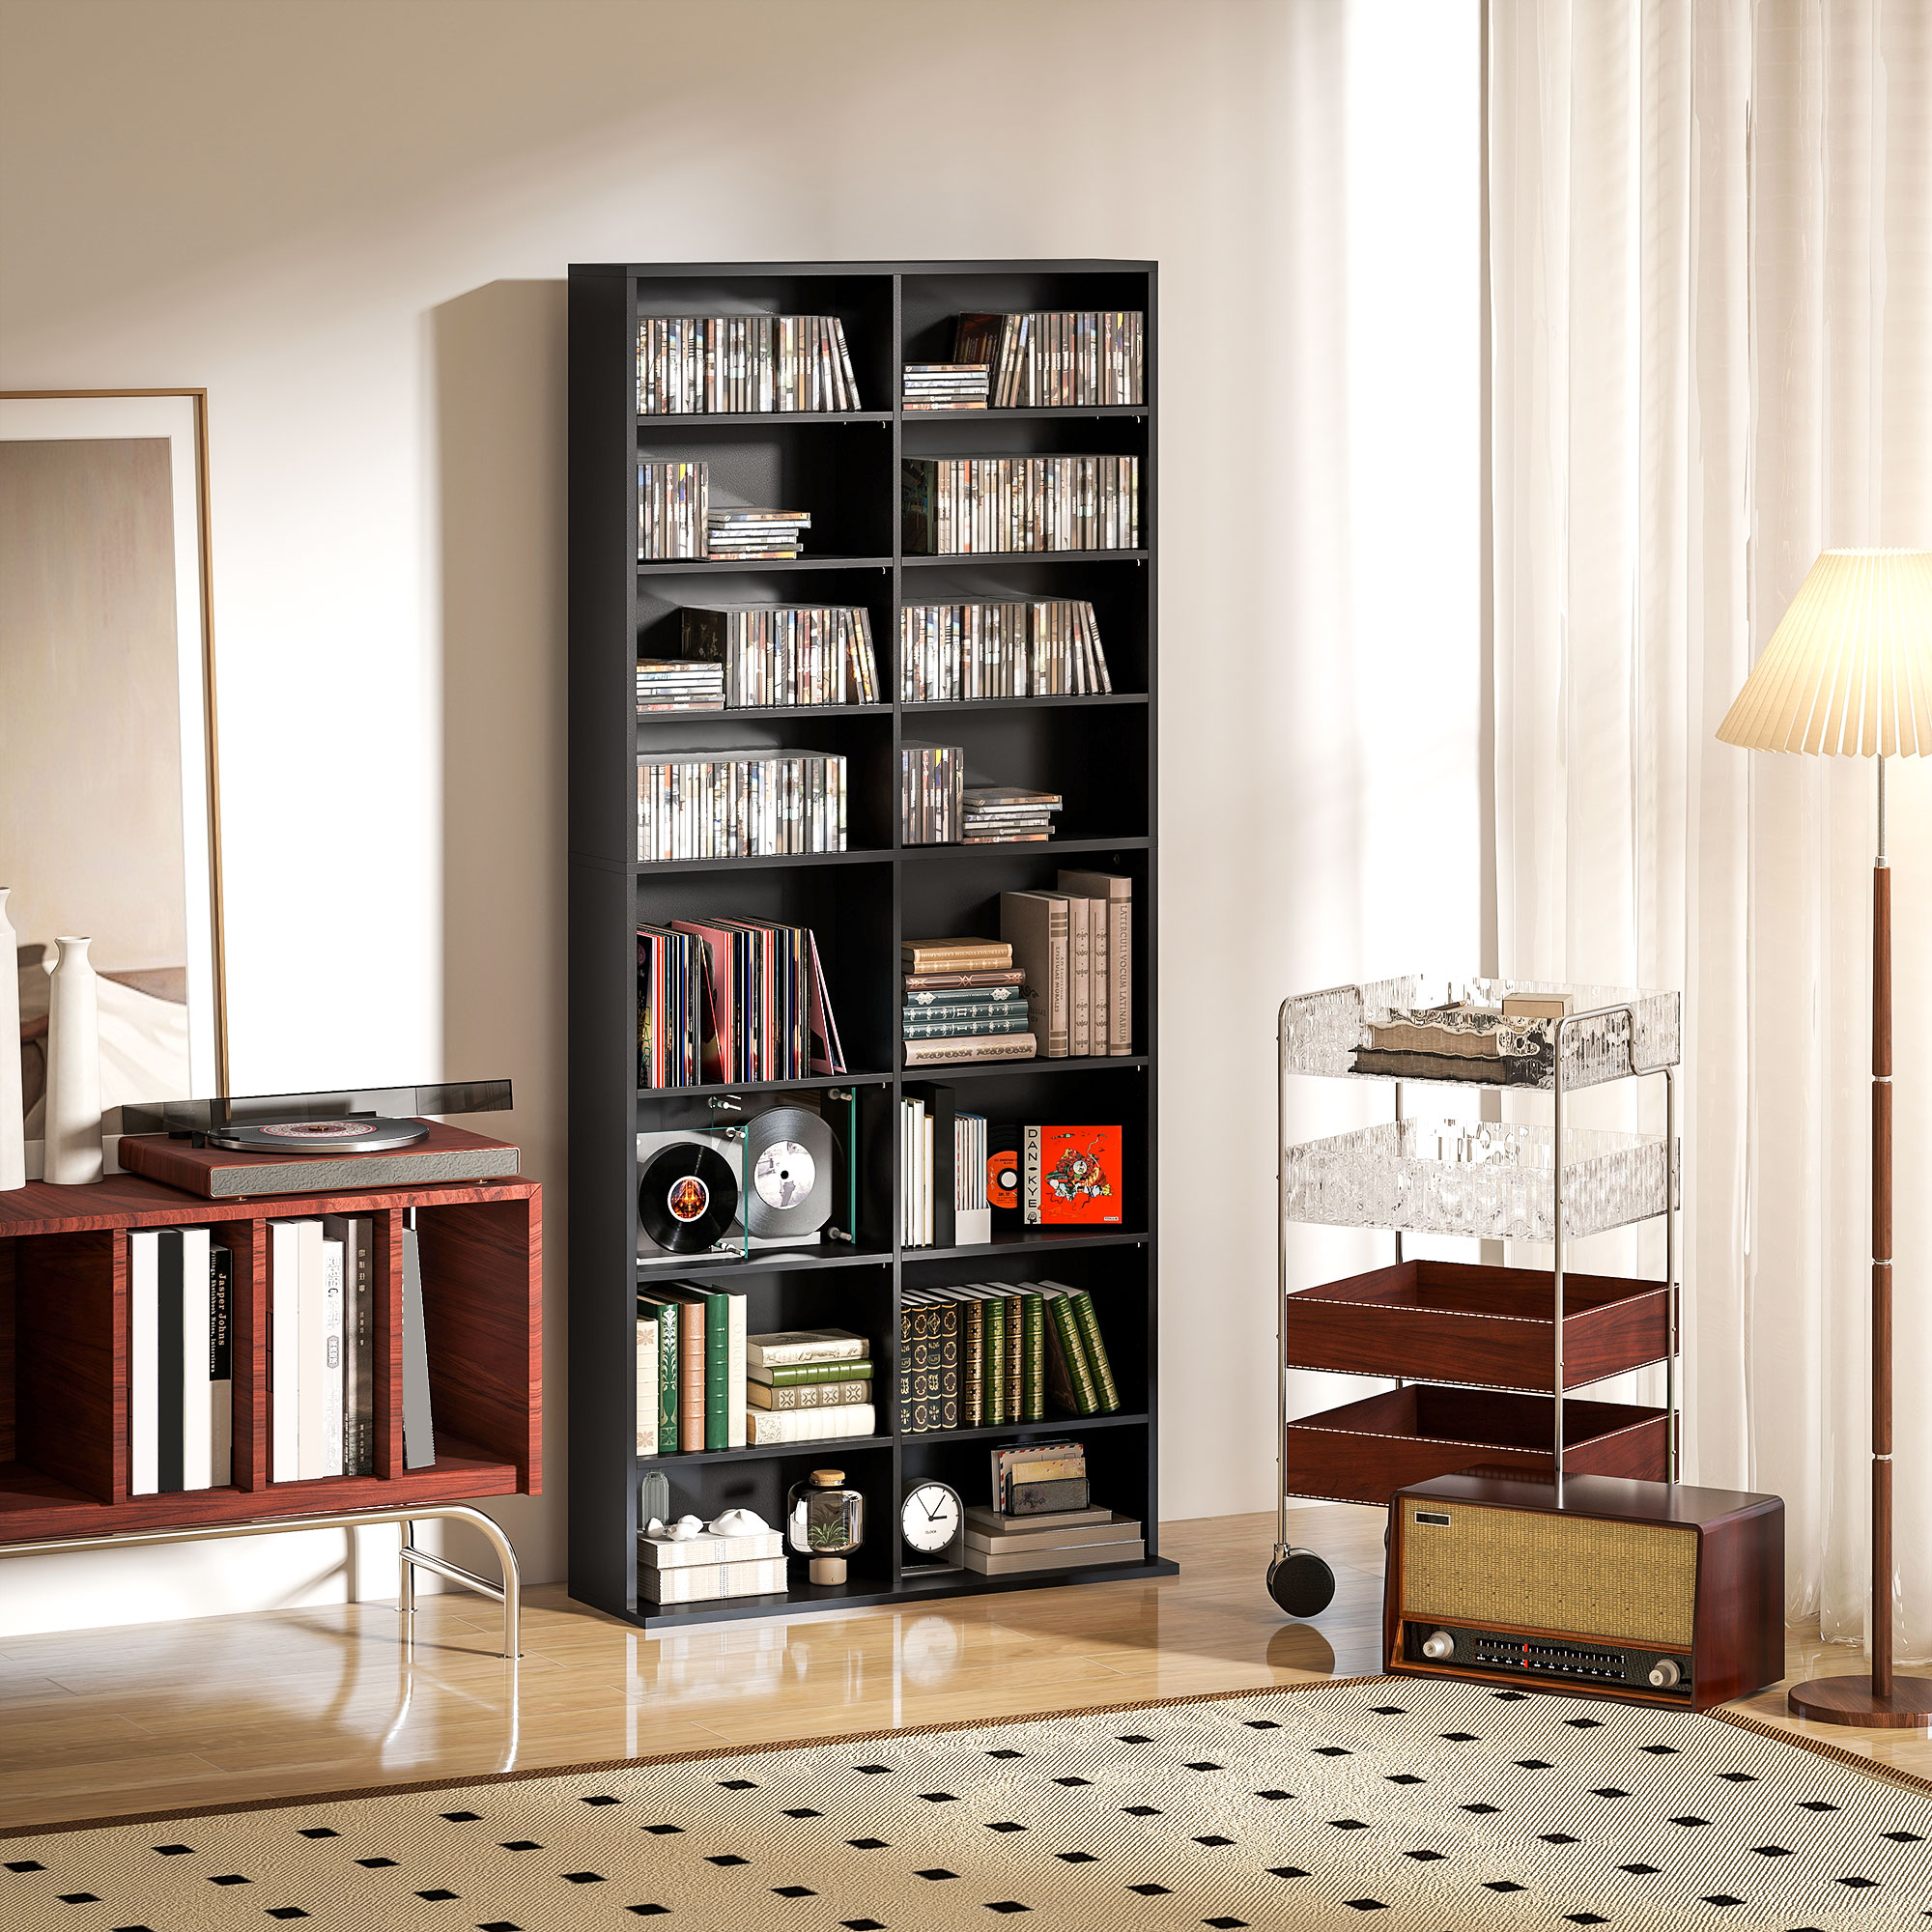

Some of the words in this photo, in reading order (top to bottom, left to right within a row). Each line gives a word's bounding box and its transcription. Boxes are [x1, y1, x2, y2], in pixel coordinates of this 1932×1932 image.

[1119, 991, 1127, 1043] LATINARUM
[216, 1273, 227, 1310] Jasper
[217, 1313, 227, 1346] Johns
